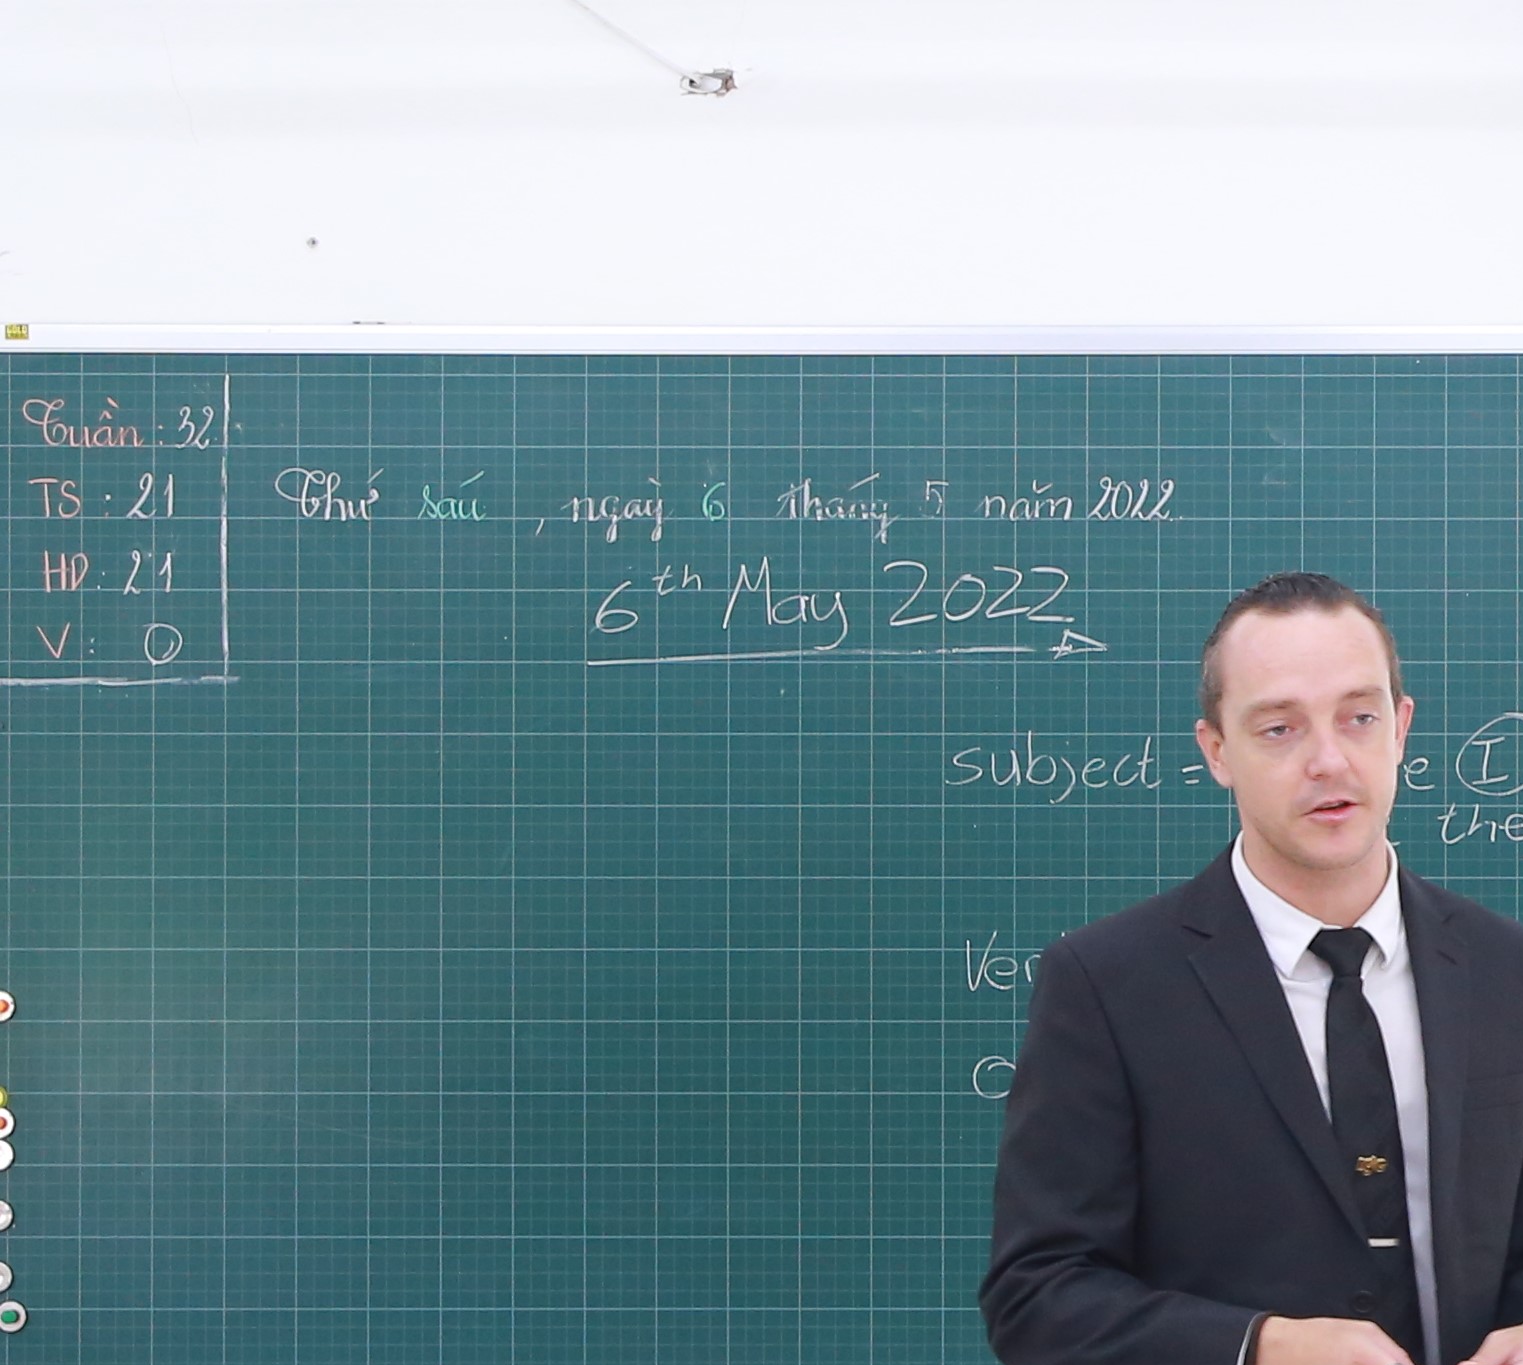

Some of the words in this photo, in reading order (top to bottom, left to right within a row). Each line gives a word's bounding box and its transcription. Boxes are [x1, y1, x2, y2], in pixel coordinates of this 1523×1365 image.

[126, 473, 174, 519] 21
[701, 480, 725, 523] 6
[925, 478, 949, 519] 5
[977, 479, 1073, 523] năm
[123, 549, 173, 595] 21
[722, 555, 849, 651] May
[882, 560, 1075, 627] 2022
[944, 730, 1164, 804] subject
